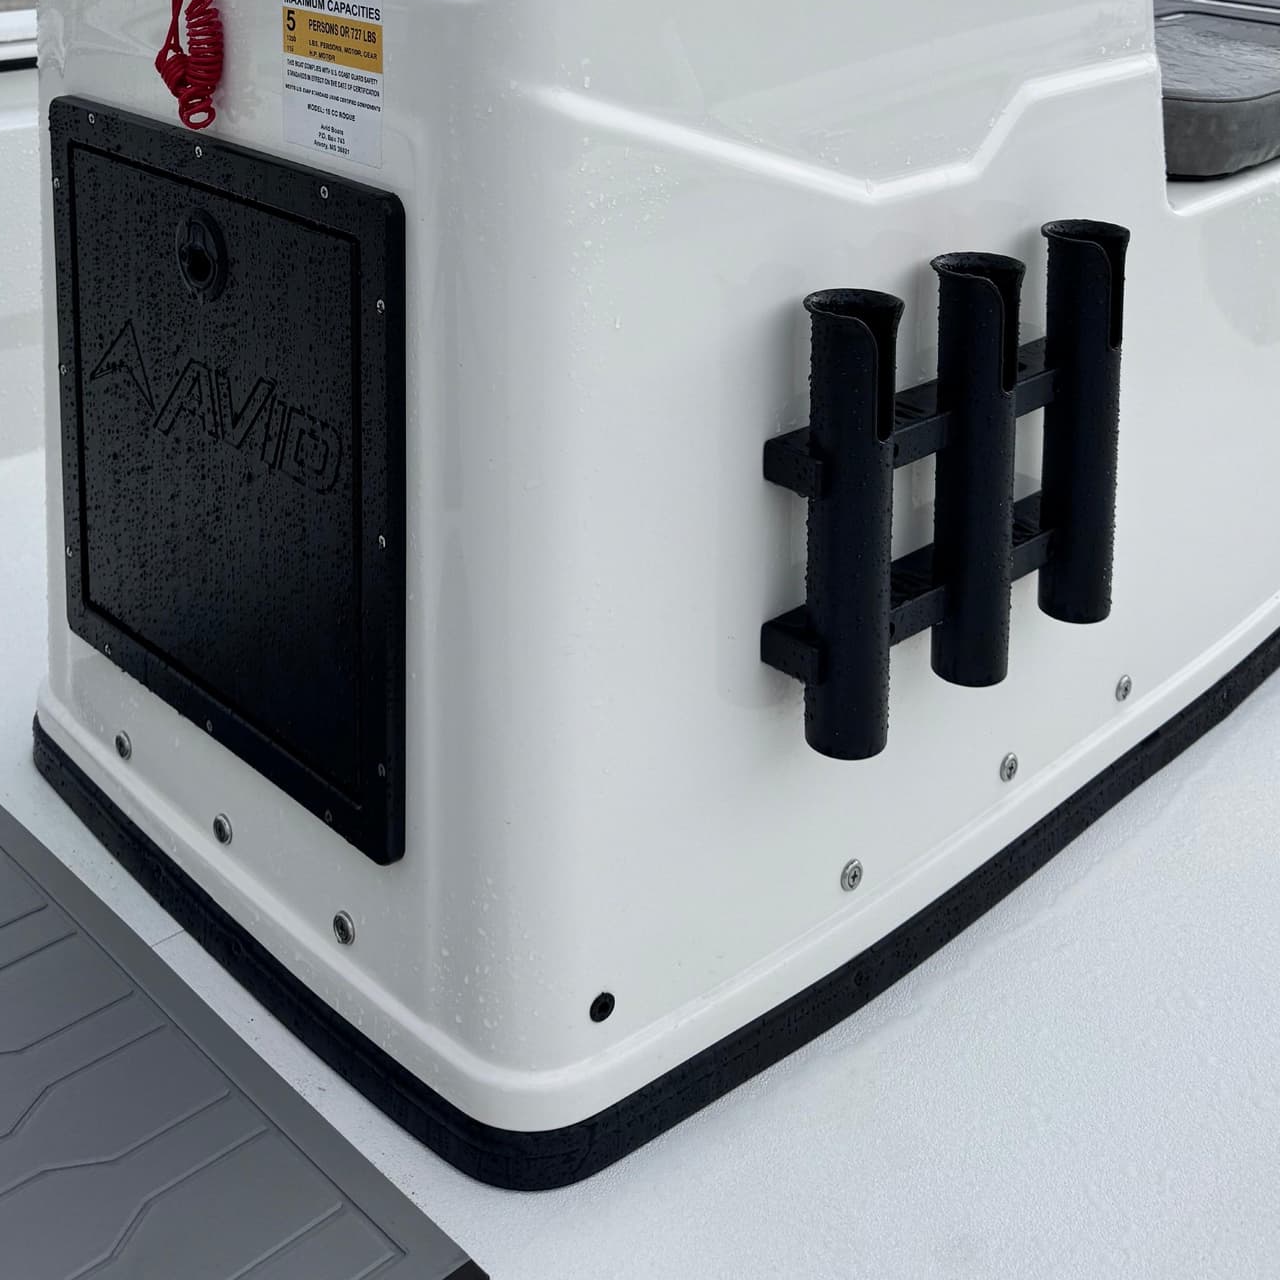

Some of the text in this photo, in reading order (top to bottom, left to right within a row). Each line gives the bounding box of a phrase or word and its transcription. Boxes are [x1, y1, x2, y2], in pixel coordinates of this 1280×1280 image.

[327, 0, 380, 20] CAPACITIES
[286, 10, 376, 44] 5 PERSONS OR 727 LBS
[319, 52, 335, 61] MOTOR
[363, 52, 377, 60] GEAR
[339, 112, 355, 122] ROGUE
